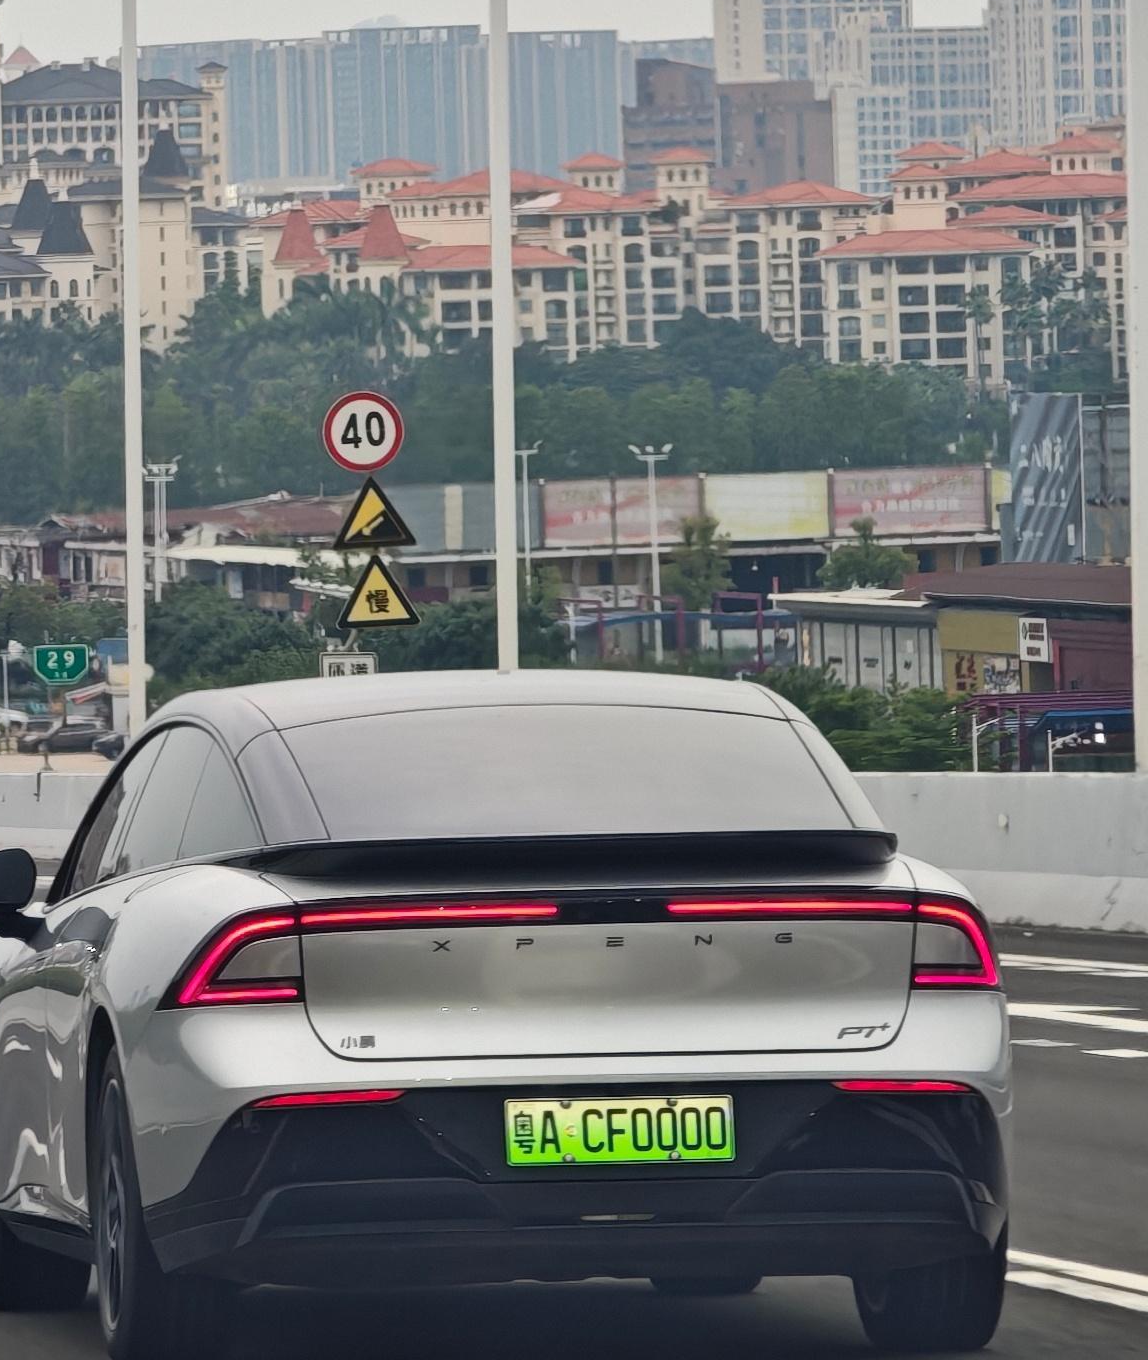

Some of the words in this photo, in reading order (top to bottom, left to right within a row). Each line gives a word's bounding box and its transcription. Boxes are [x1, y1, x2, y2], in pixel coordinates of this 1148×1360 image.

[340, 411, 386, 449] 40
[365, 589, 390, 614] 慢
[47, 650, 75, 669] 29
